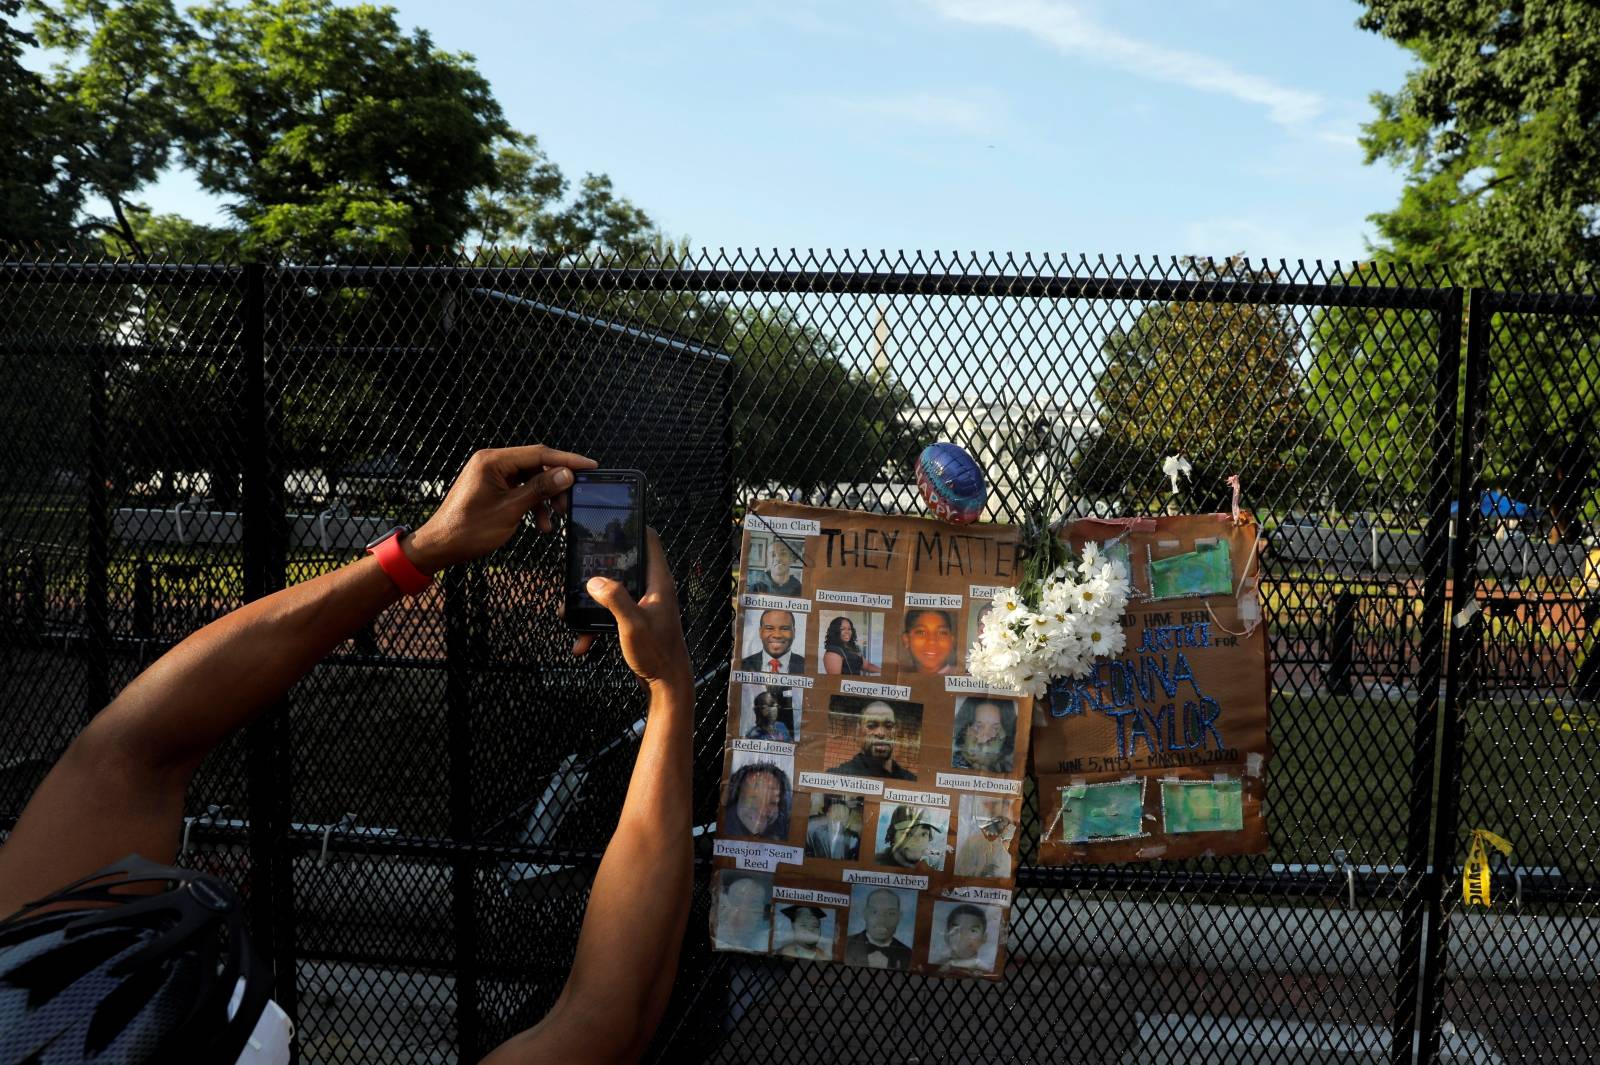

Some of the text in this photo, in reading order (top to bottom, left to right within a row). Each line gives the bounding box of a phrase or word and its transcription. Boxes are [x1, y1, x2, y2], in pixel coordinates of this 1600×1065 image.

[747, 519, 817, 532] Stephon Clark
[820, 528, 900, 571] THEY
[745, 596, 810, 611] Botham Jean
[818, 592, 892, 606] Breonna Taylor
[907, 596, 961, 607] Tamir Rice
[1143, 611, 1172, 628] HAVE
[1181, 609, 1211, 625] BEEN
[1214, 636, 1241, 649] FOR
[735, 673, 814, 688] Philando Castile
[948, 678, 990, 689] Michelle
[1050, 652, 1203, 718] BREONNA
[843, 684, 909, 698] George Floyd
[1105, 695, 1226, 761] TAYLOR
[734, 741, 793, 754] Redel Jones
[1057, 758, 1084, 772] JUNE
[1148, 752, 1185, 769] MARCH
[801, 774, 880, 790] Kenney Watkins
[938, 776, 973, 788] Laquan
[886, 791, 948, 805] Jamar Clark
[716, 843, 761, 857] Dreasjon
[743, 859, 769, 869] Reed
[847, 872, 928, 889] Ahmaud Arbery
[775, 890, 849, 905] Michael Brown
[973, 889, 1009, 901] Martin
